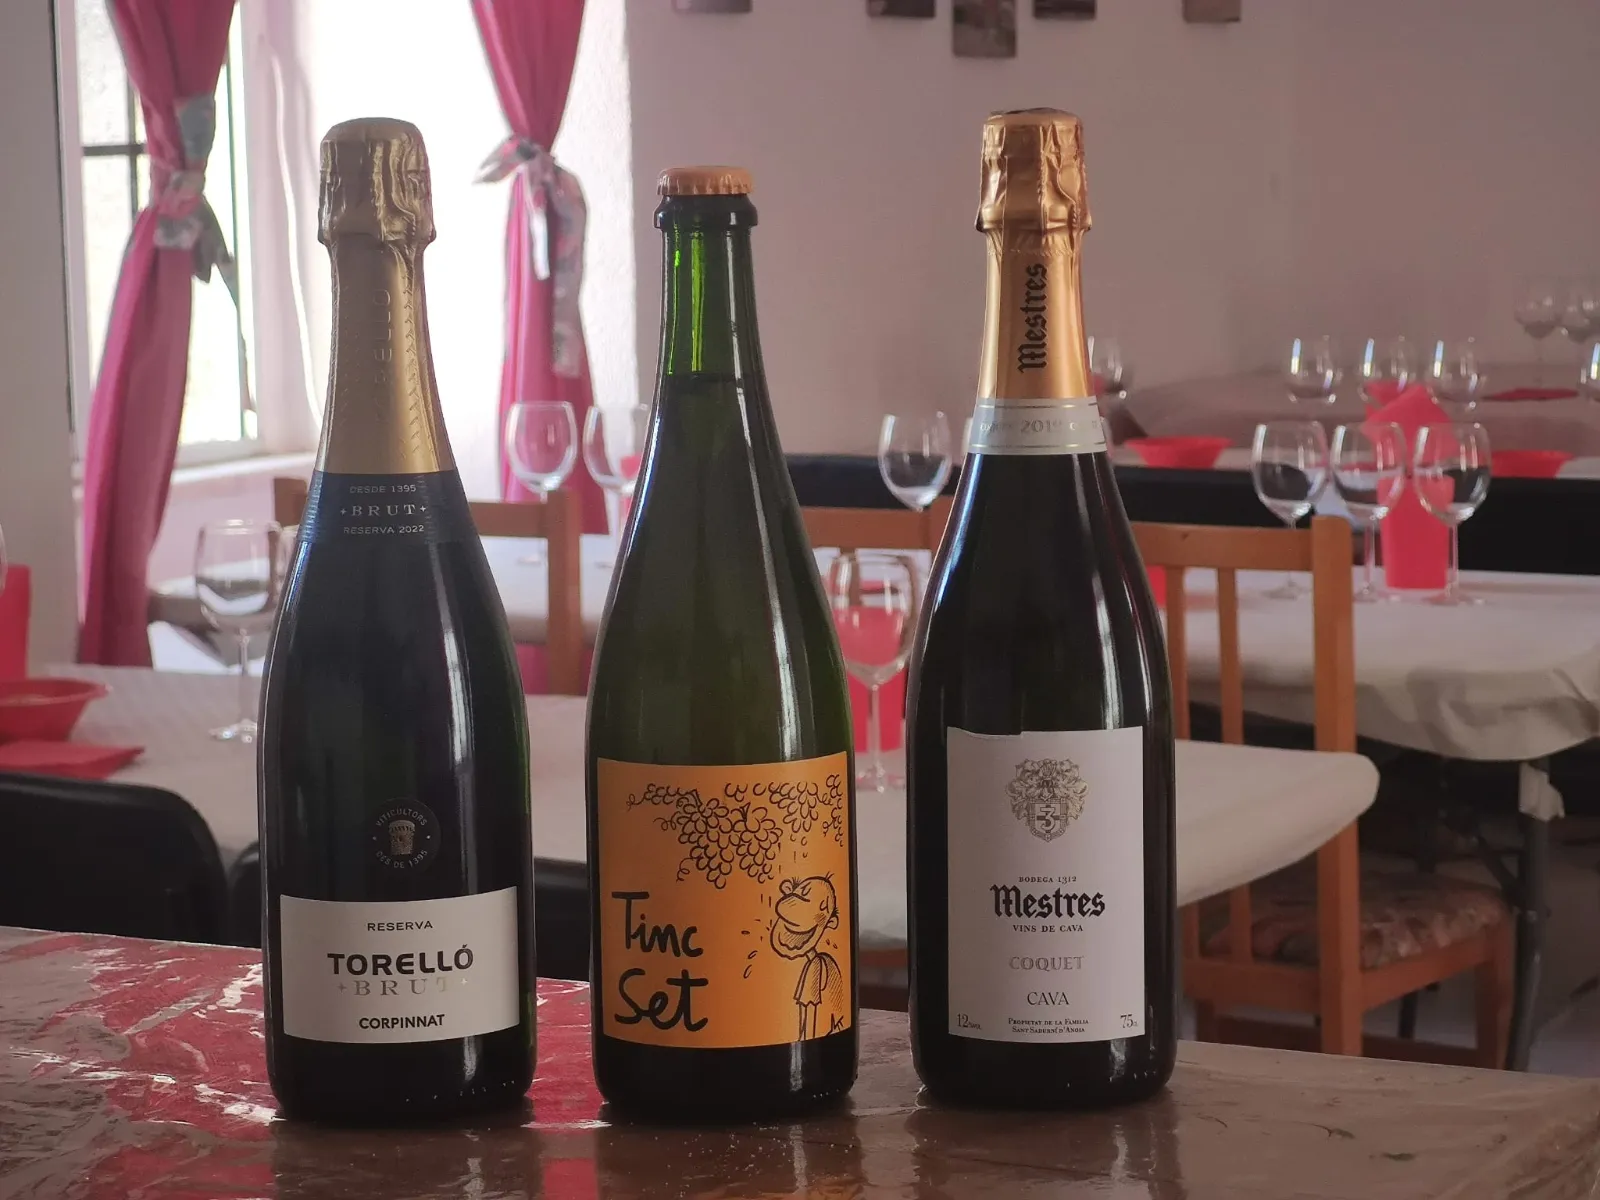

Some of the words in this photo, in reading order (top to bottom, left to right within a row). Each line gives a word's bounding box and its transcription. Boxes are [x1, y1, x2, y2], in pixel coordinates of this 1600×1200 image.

[1017, 263, 1048, 374] Mestres
[350, 485, 386, 494] DESDE
[391, 484, 416, 493] 1395
[352, 504, 416, 516] BRUT
[343, 526, 395, 535] RESERVA
[399, 524, 424, 534] 2022
[375, 808, 428, 827] VITICULTORS
[1058, 875, 1077, 884] 1312
[989, 884, 1106, 919] Mestres
[367, 920, 434, 932] RESERVA
[1012, 924, 1037, 933] VINS
[1041, 924, 1056, 933] DE
[1059, 924, 1084, 933] CAVA
[327, 944, 474, 976] TORELLÓ
[1008, 955, 1085, 972] COQUET
[353, 977, 449, 996] BRUT
[614, 967, 709, 1032] Set
[1026, 991, 1070, 1006] CAVA
[358, 1014, 445, 1029] CORPINNAT
